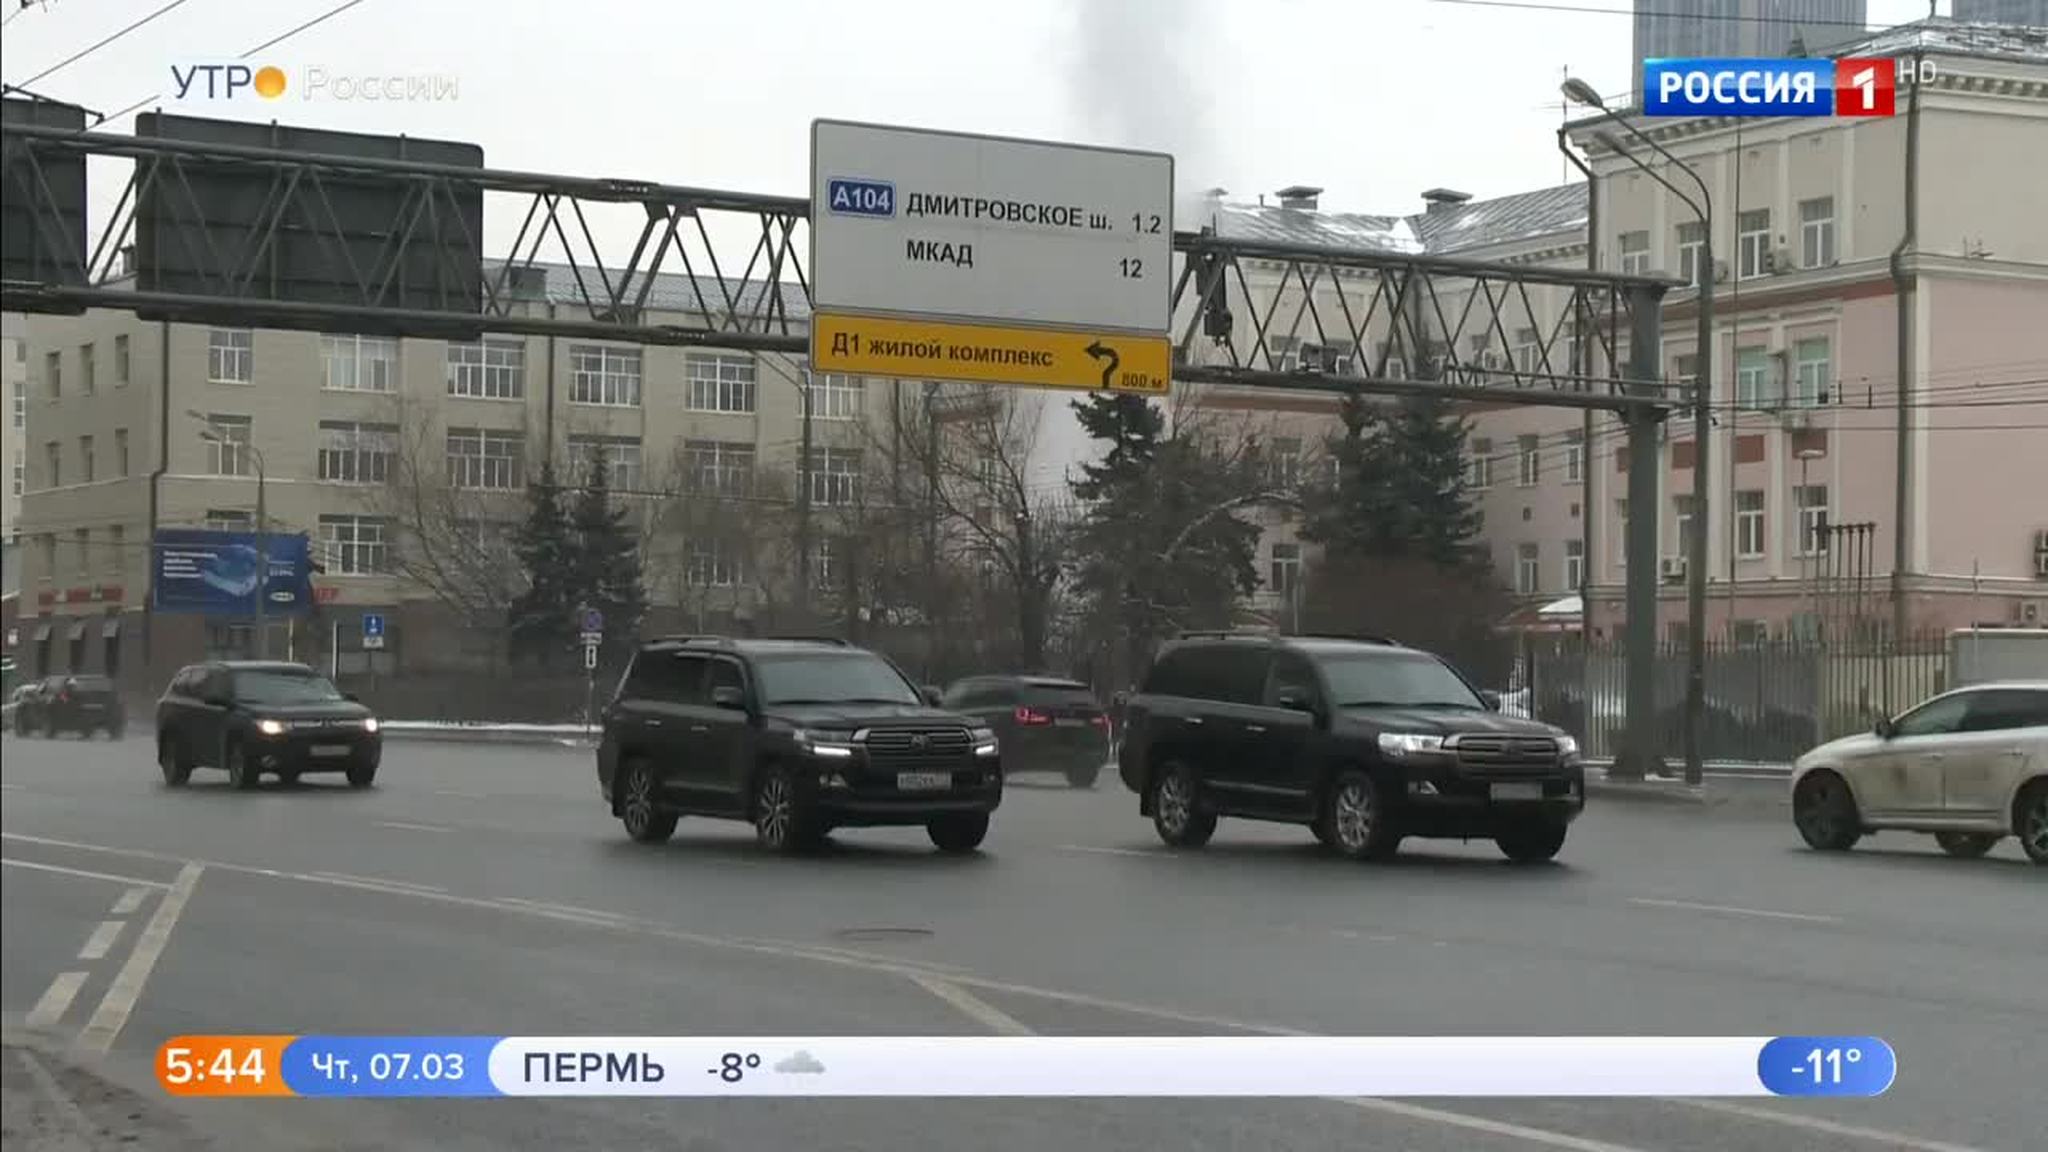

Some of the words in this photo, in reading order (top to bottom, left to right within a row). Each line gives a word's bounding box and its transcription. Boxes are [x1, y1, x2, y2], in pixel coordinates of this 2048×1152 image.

[906, 193, 1083, 228] ДМИТРОВСКОЕ
[1089, 214, 1113, 231] ш.
[1131, 214, 1161, 235] 1.2
[906, 240, 973, 268] МКАД
[1119, 258, 1143, 279] 12
[832, 333, 860, 357] Д1
[869, 338, 942, 360] жилой
[948, 346, 1053, 367] комплекс
[1121, 371, 1147, 388] 800
